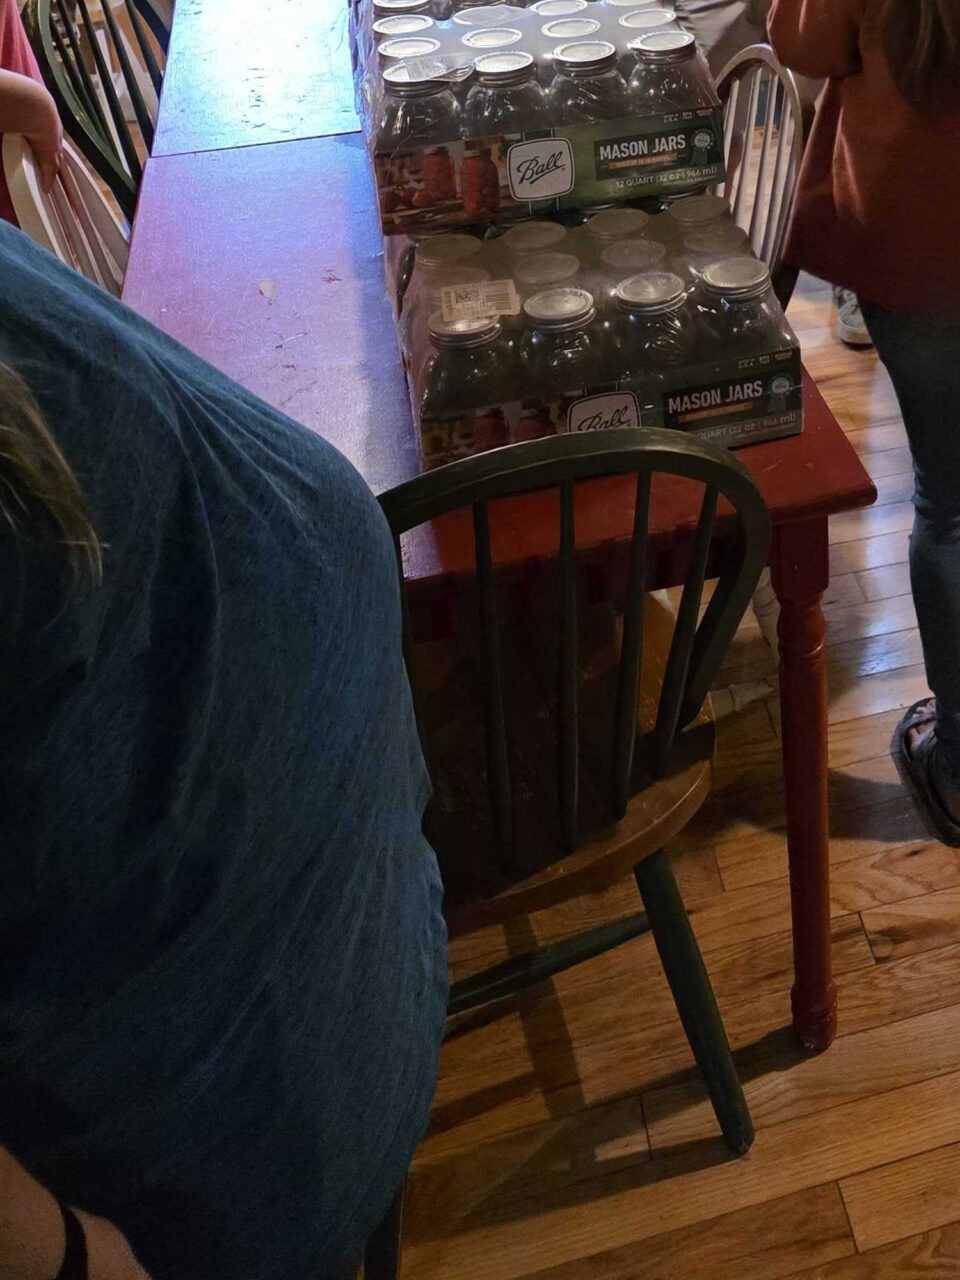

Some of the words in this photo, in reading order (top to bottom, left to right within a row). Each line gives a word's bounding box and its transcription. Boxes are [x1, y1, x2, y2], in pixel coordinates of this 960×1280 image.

[599, 140, 648, 161] MASON
[652, 134, 686, 153] JARS
[516, 151, 566, 184] Ball
[626, 176, 655, 187] QUART
[668, 393, 720, 414] MASON
[725, 380, 764, 403] JARS
[577, 406, 633, 430] Ball
